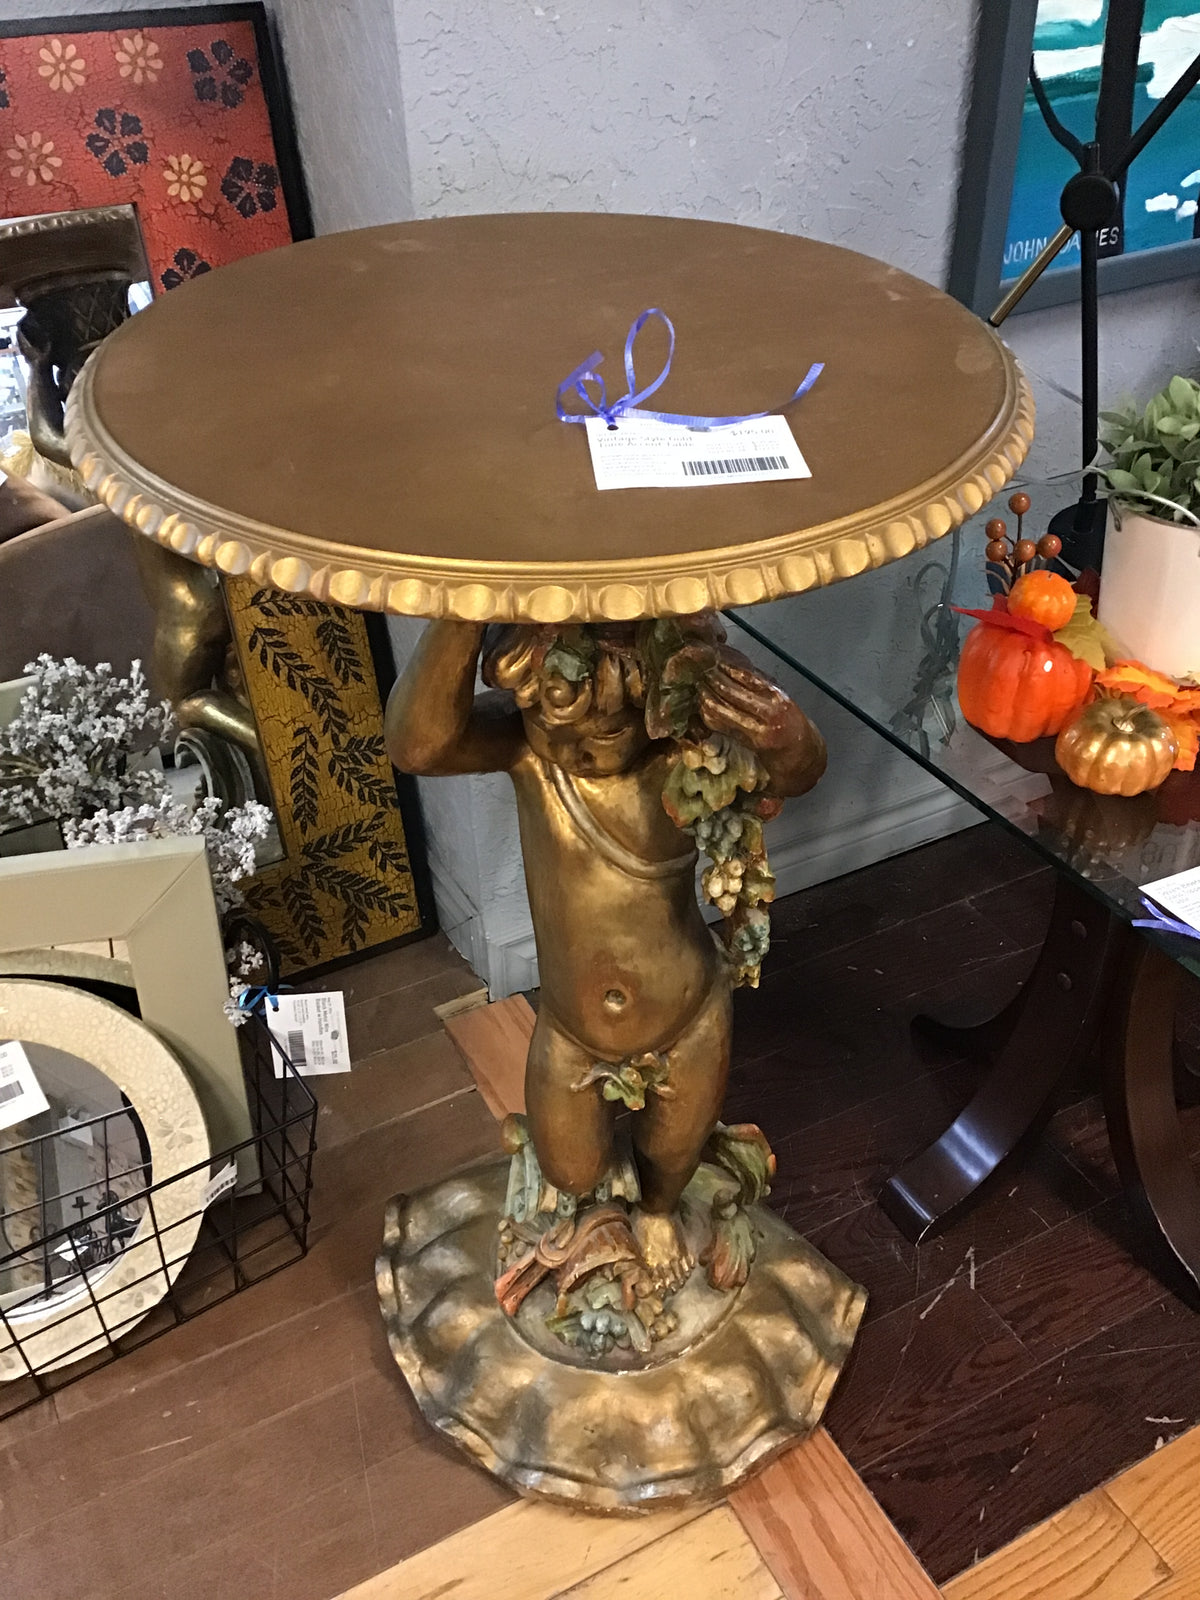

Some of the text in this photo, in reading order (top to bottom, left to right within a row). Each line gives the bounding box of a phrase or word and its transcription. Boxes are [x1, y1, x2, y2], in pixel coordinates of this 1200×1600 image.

[1003, 226, 1120, 265] JOHN AES
[597, 436, 637, 444] Vintage
